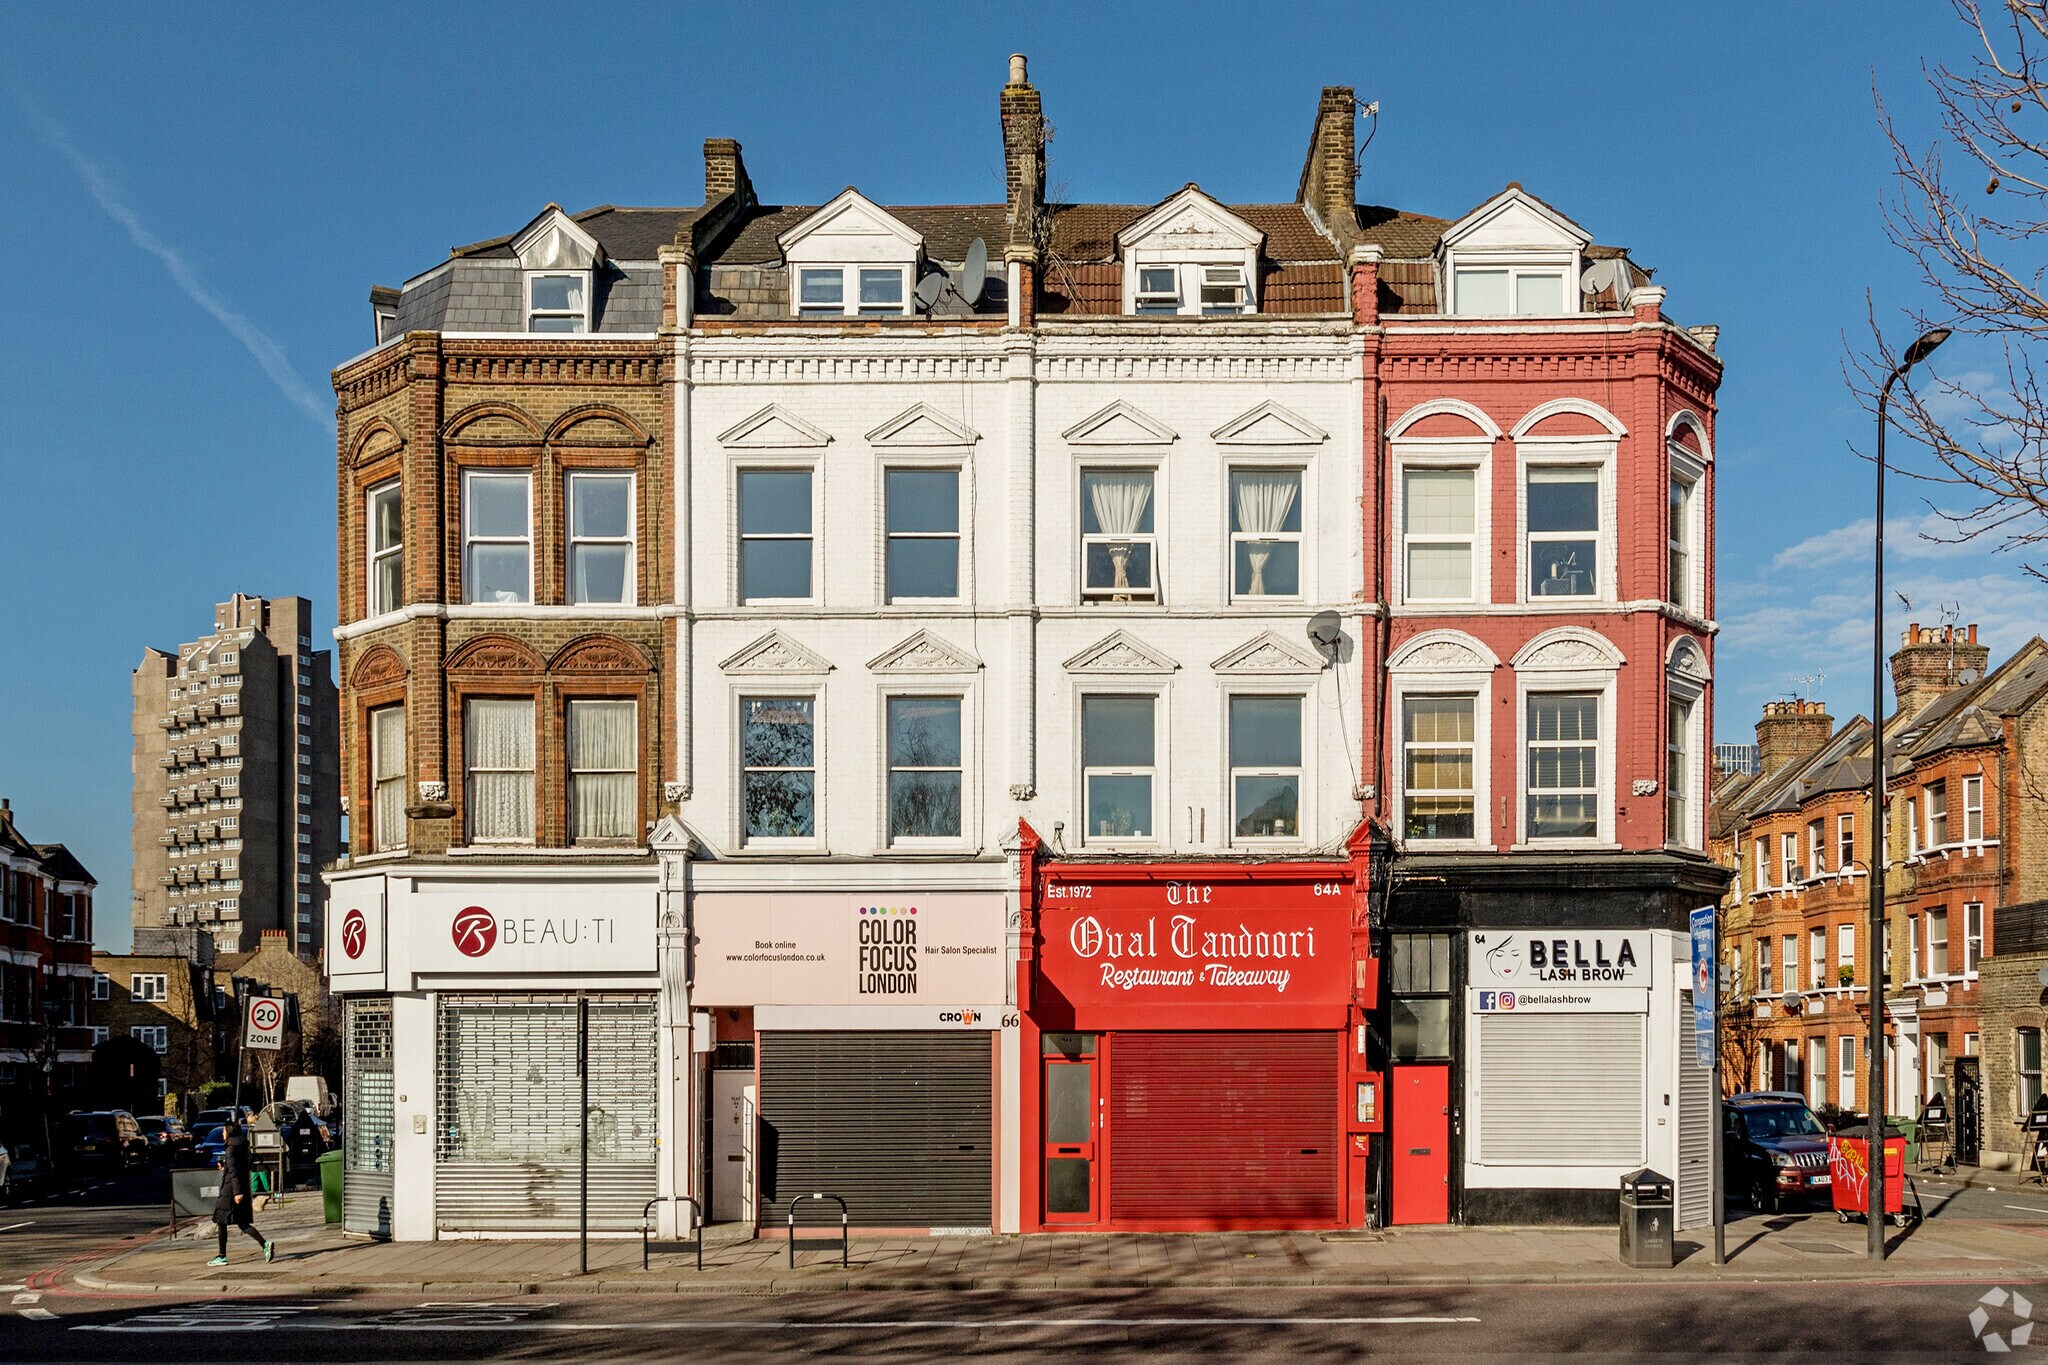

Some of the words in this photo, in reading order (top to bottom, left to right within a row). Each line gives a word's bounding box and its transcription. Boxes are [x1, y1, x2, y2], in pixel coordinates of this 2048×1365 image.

[1047, 884, 1092, 899] Est.1972
[1166, 880, 1213, 905] The
[1313, 883, 1342, 896] 64A
[858, 918, 917, 945] COLOR
[1070, 916, 1157, 958] Oval
[1170, 914, 1316, 959] Tandoori
[1474, 934, 1486, 944] 64
[754, 940, 773, 949] Book
[774, 940, 797, 949] online
[924, 946, 939, 955] Hair
[940, 946, 960, 955] Salon
[961, 946, 998, 956] Specialist
[725, 953, 826, 962] www.colorfocuslondon.co.uk
[858, 945, 917, 972] FOCUS
[1530, 939, 1637, 968] BELLA
[1099, 962, 1194, 990] Restaurant
[1204, 963, 1290, 992] Takeaway
[1539, 969, 1577, 981] LASH
[1582, 969, 1625, 981] BROW
[858, 973, 918, 994] LONDON
[1518, 995, 1591, 1005] @bellalashbrow
[256, 1009, 277, 1022] 20
[939, 1008, 981, 1025] CROWN
[1001, 1013, 1019, 1028] 66
[250, 1034, 277, 1043] ZONE
